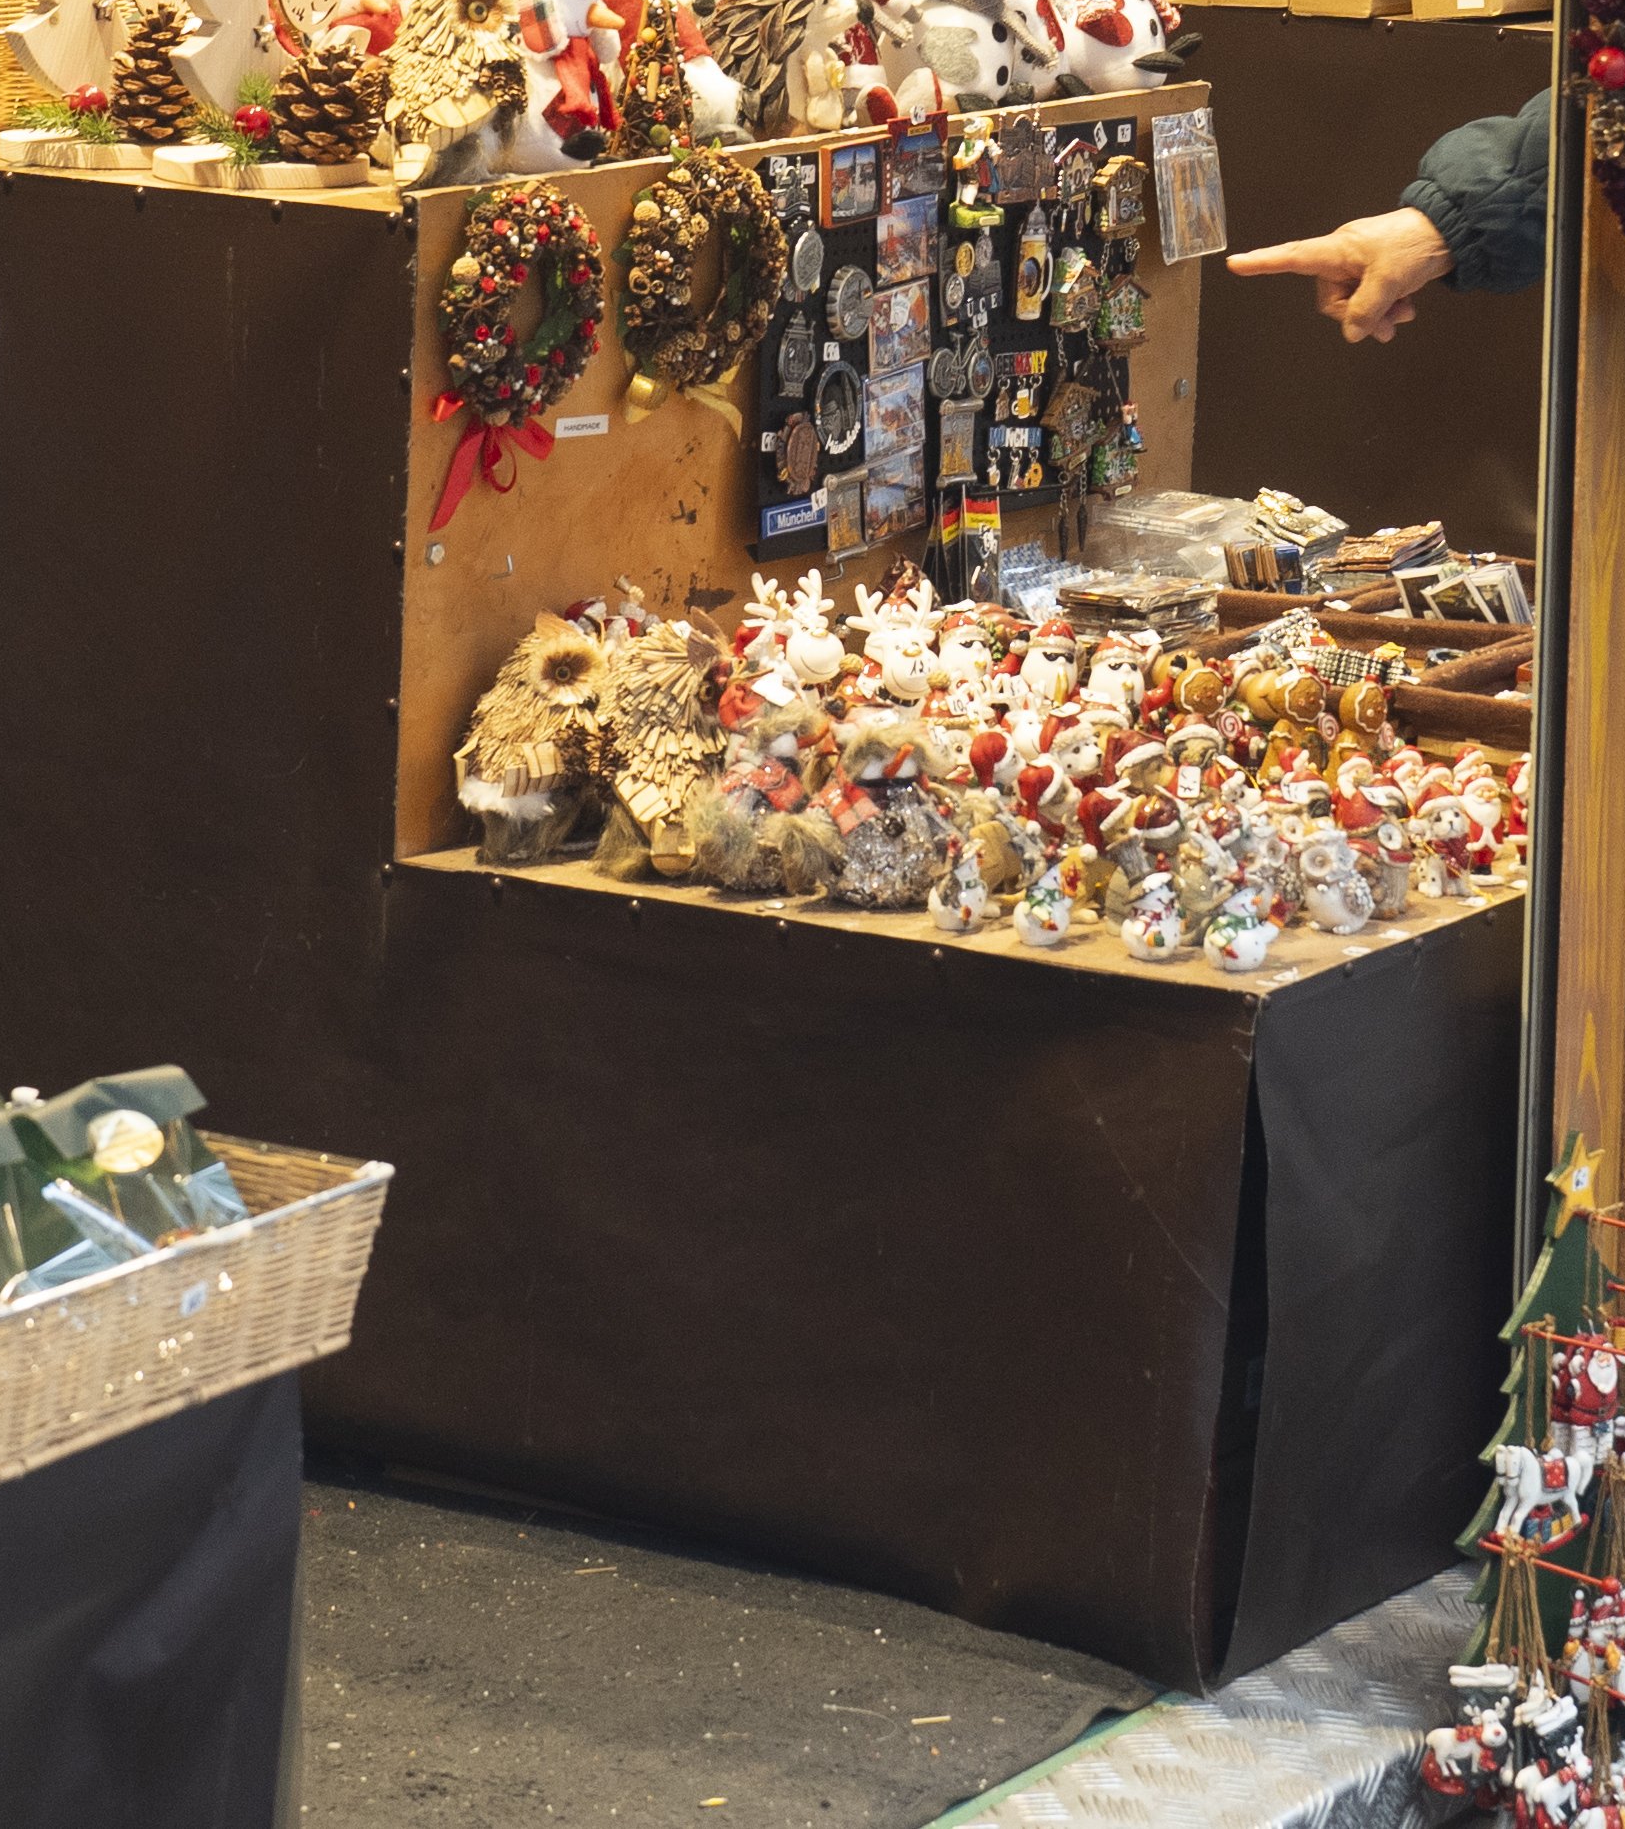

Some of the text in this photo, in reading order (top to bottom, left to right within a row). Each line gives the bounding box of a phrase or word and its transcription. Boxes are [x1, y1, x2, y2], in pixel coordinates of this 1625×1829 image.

[995, 349, 1048, 378] GERMANY
[563, 421, 602, 433] HANDMADE
[777, 508, 818, 529] München
